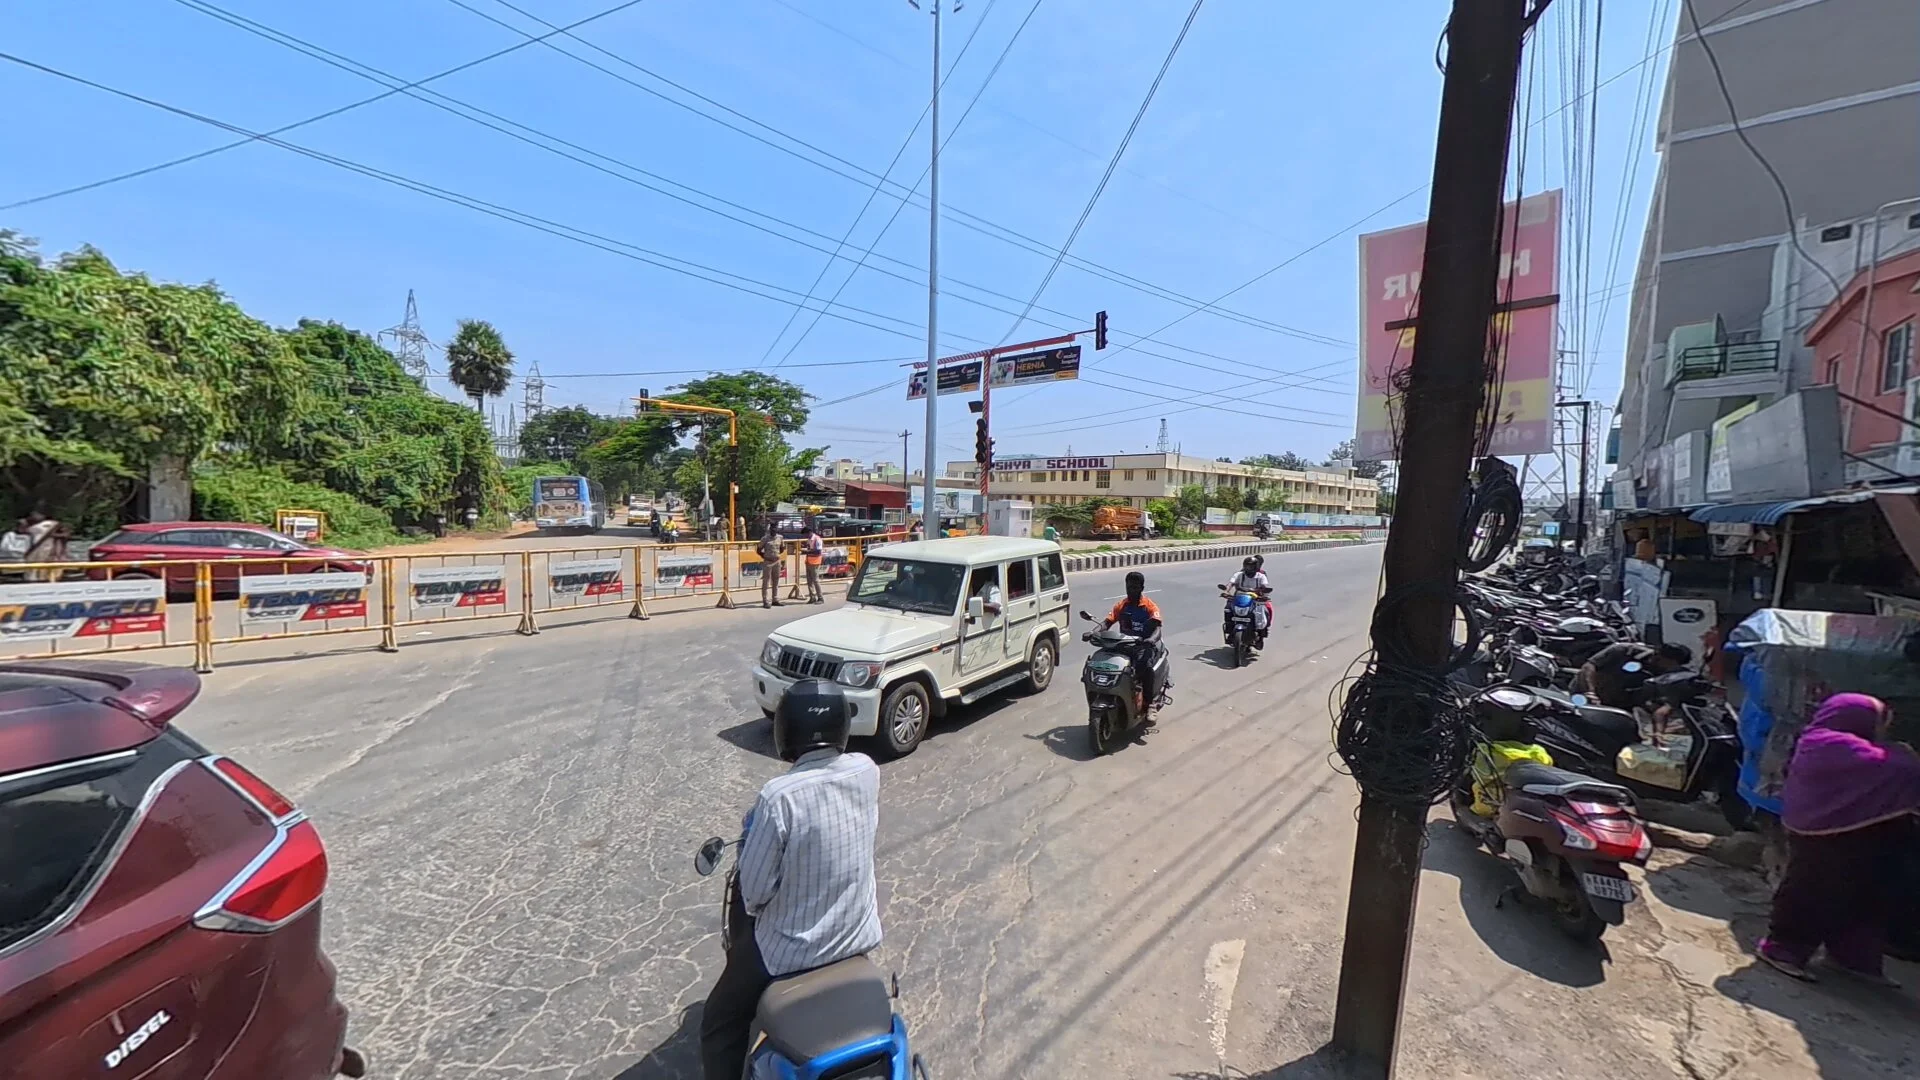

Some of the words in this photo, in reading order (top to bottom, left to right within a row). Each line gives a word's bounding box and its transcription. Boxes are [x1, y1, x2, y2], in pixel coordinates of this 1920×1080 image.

[1017, 360, 1046, 373] HERNIA
[1046, 458, 1108, 469] SCHOOL
[415, 579, 502, 597] TENNECO
[246, 588, 362, 609] TENNECO
[104, 1009, 171, 1068] DIESEL
